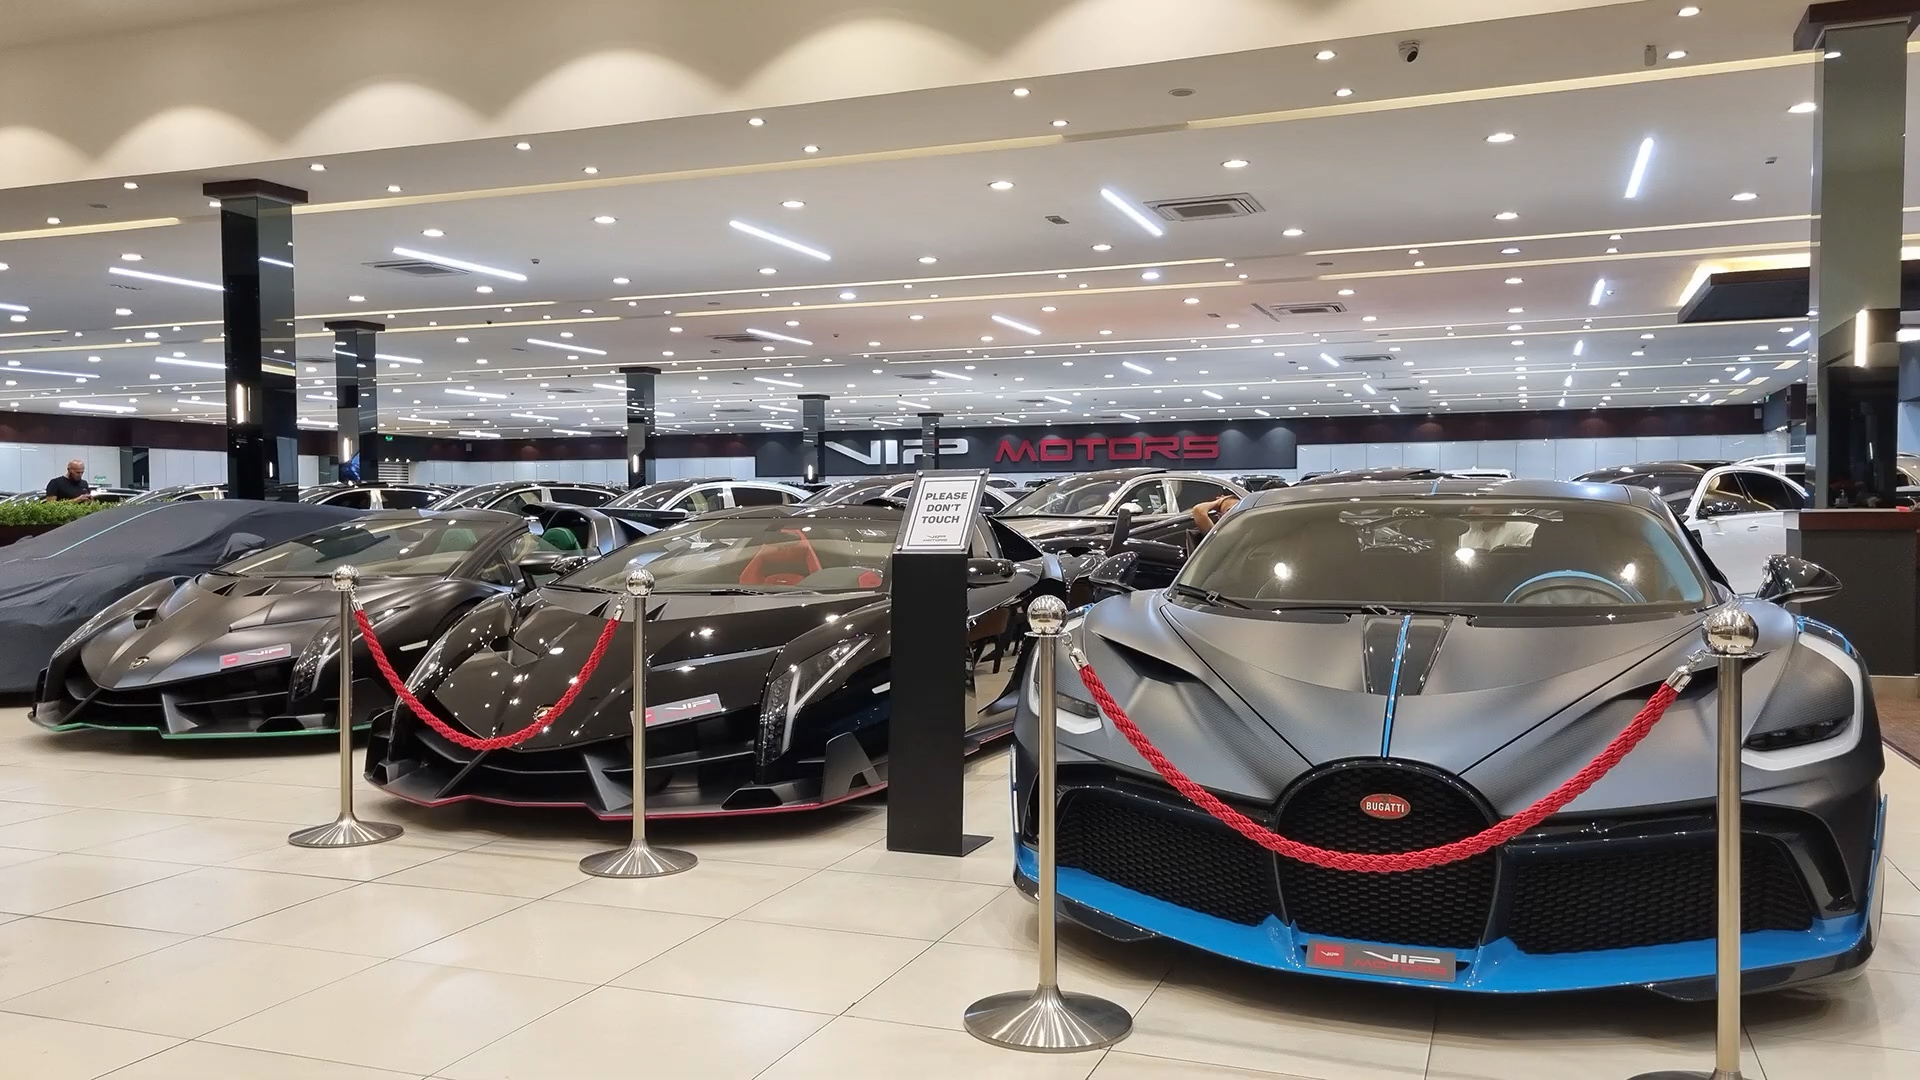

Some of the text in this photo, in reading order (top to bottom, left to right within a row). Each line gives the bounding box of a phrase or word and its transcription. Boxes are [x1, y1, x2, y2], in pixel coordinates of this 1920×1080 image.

[825, 435, 1219, 465] VIP MOTORS
[925, 492, 968, 500] PLEASE
[926, 504, 961, 512] DON'T
[921, 516, 960, 524] TOUCH
[1366, 801, 1405, 813] BUGATTI
[1362, 950, 1440, 964] VIP
